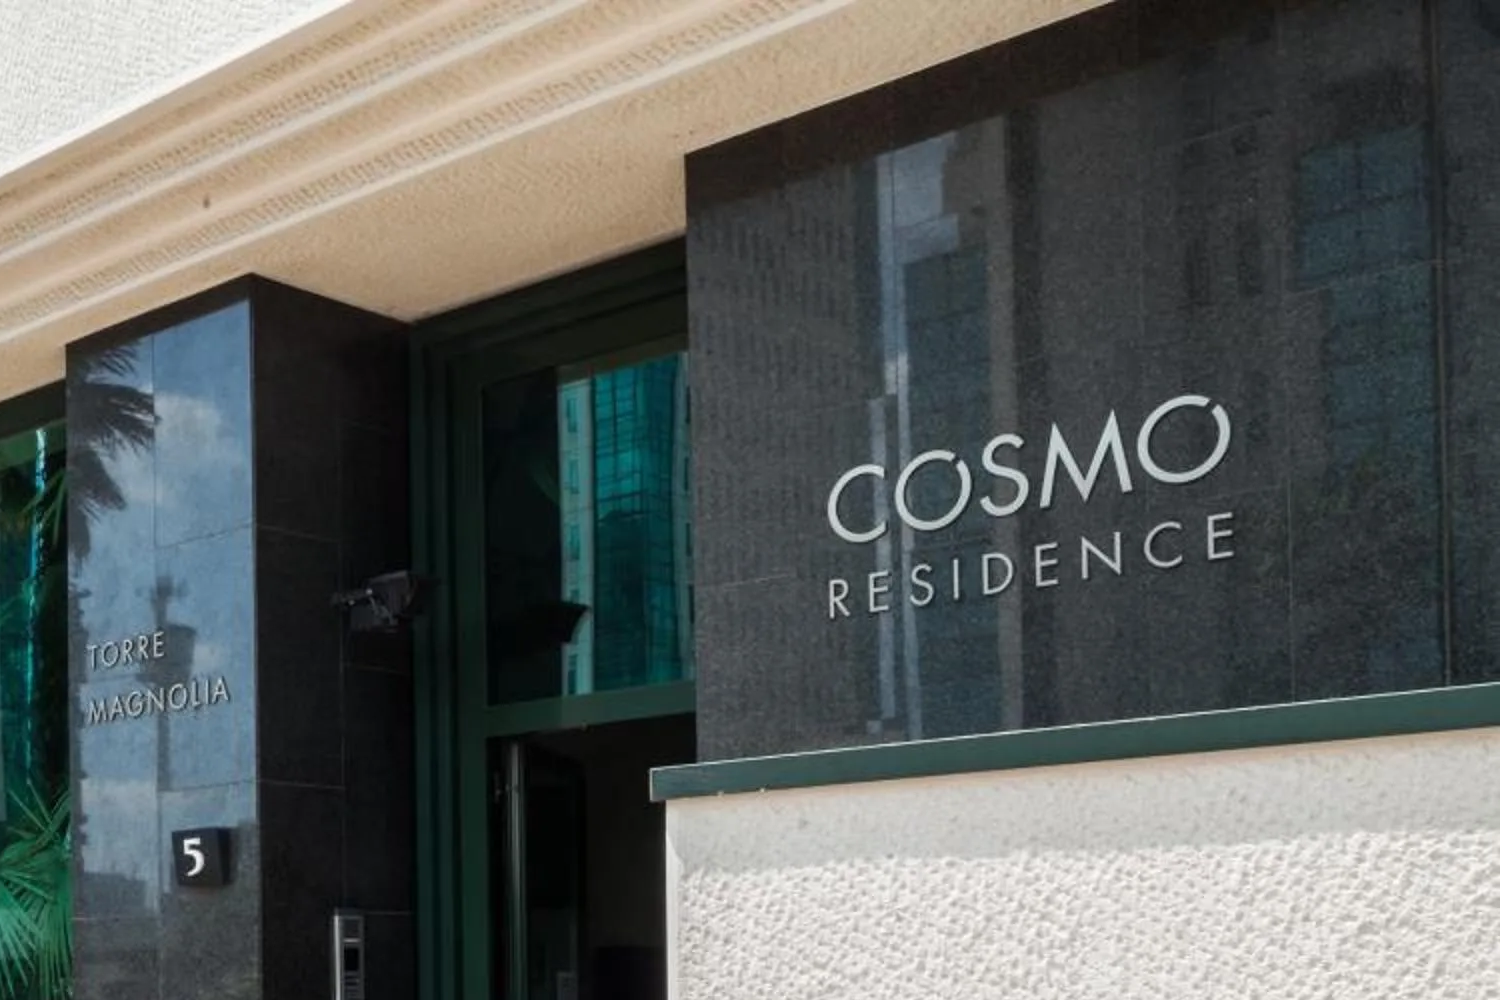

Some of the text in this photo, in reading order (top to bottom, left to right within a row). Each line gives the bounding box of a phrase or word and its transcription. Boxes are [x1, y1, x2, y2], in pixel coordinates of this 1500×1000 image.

[827, 395, 1231, 543] COSMO
[828, 511, 1235, 619] RESIDENCE
[86, 631, 166, 670] TORRE
[86, 676, 231, 725] MAGNOLIA
[182, 837, 205, 877] 5
